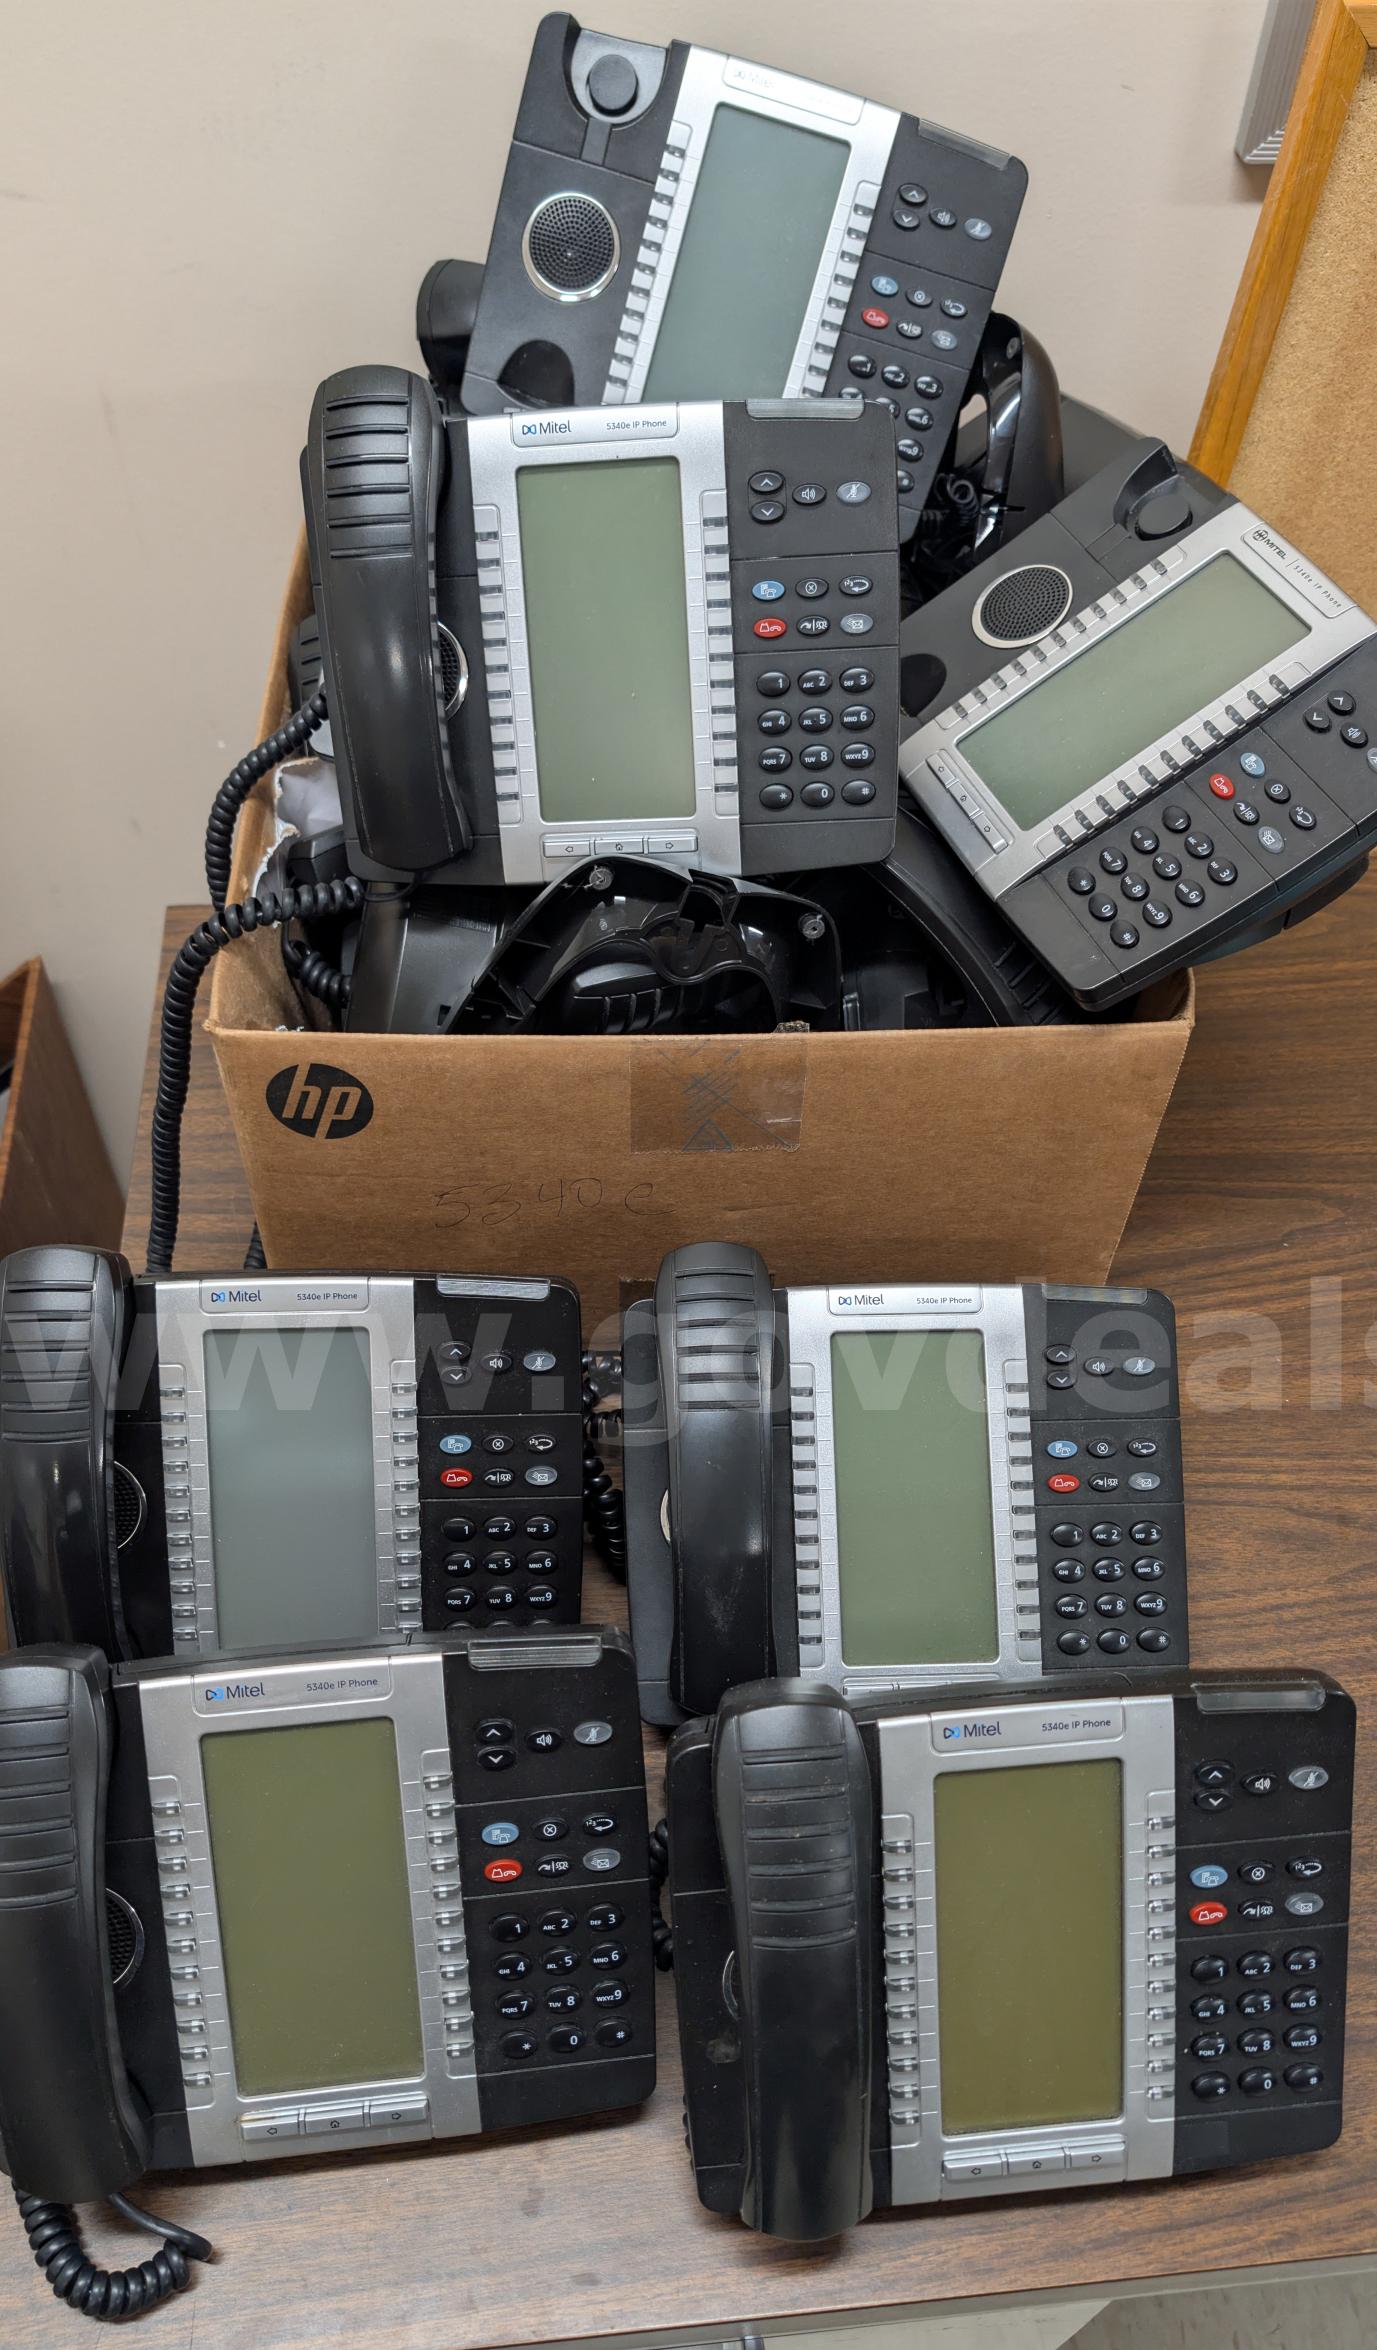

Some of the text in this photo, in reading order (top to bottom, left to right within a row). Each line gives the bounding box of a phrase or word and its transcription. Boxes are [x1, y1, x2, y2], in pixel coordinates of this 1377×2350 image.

[539, 420, 571, 435] Mitel
[606, 419, 667, 431] 5340e IP Phone
[1264, 538, 1288, 559] MITEL
[819, 676, 825, 687] 2
[860, 675, 867, 685] 3
[778, 716, 785, 726] 4
[819, 714, 826, 725] 5
[860, 711, 867, 722] 6
[779, 754, 786, 765] 7
[820, 751, 827, 762] 8
[861, 749, 868, 760] 9
[821, 788, 828, 799] 0
[282, 1063, 362, 1139] hp
[229, 1289, 262, 1302] Mitel
[296, 1293, 321, 1301] 5340e
[333, 1292, 358, 1300] Phone
[854, 1293, 885, 1305] Mitel
[503, 1523, 511, 1532] 2
[542, 1523, 549, 1533] 3
[1111, 1530, 1118, 1539] 2
[1150, 1529, 1157, 1538] 3
[463, 1560, 471, 1569] 4
[504, 1559, 511, 1568] 5
[544, 1558, 552, 1568] 6
[1153, 1563, 1160, 1572] 6
[1074, 1566, 1081, 1575] 4
[1114, 1564, 1121, 1574] 5
[464, 1595, 471, 1605] 7
[505, 1593, 512, 1603] 8
[546, 1592, 552, 1601] 9
[1077, 1602, 1084, 1611] 7
[1116, 1601, 1123, 1610] 8
[1156, 1599, 1163, 1608] 9
[1119, 1636, 1126, 1645] 0
[306, 1677, 378, 1692] 5340e IP Phone
[226, 1682, 265, 1700] Mitel
[963, 1720, 1002, 1738] Mitel
[1041, 1718, 1111, 1732] 5340e IP Phone
[561, 1919, 569, 1929] 2
[608, 1914, 616, 1925] 3
[564, 1956, 573, 1967] 5
[611, 1950, 619, 1962] 6
[517, 1961, 525, 1972] 4
[1263, 1962, 1271, 1973] 2
[1308, 1959, 1316, 1969] 3
[614, 1989, 622, 2000] 9
[567, 1995, 575, 2006] 8
[1263, 2000, 1271, 2011] 5
[1308, 1995, 1316, 2007] 6
[520, 2001, 528, 2012] 7
[1217, 2004, 1225, 2015] 4
[570, 2035, 578, 2046] 0
[1263, 2040, 1271, 2051] 8
[1309, 2035, 1317, 2046] 9
[1217, 2044, 1225, 2054] 7
[1264, 2079, 1272, 2090] 0
